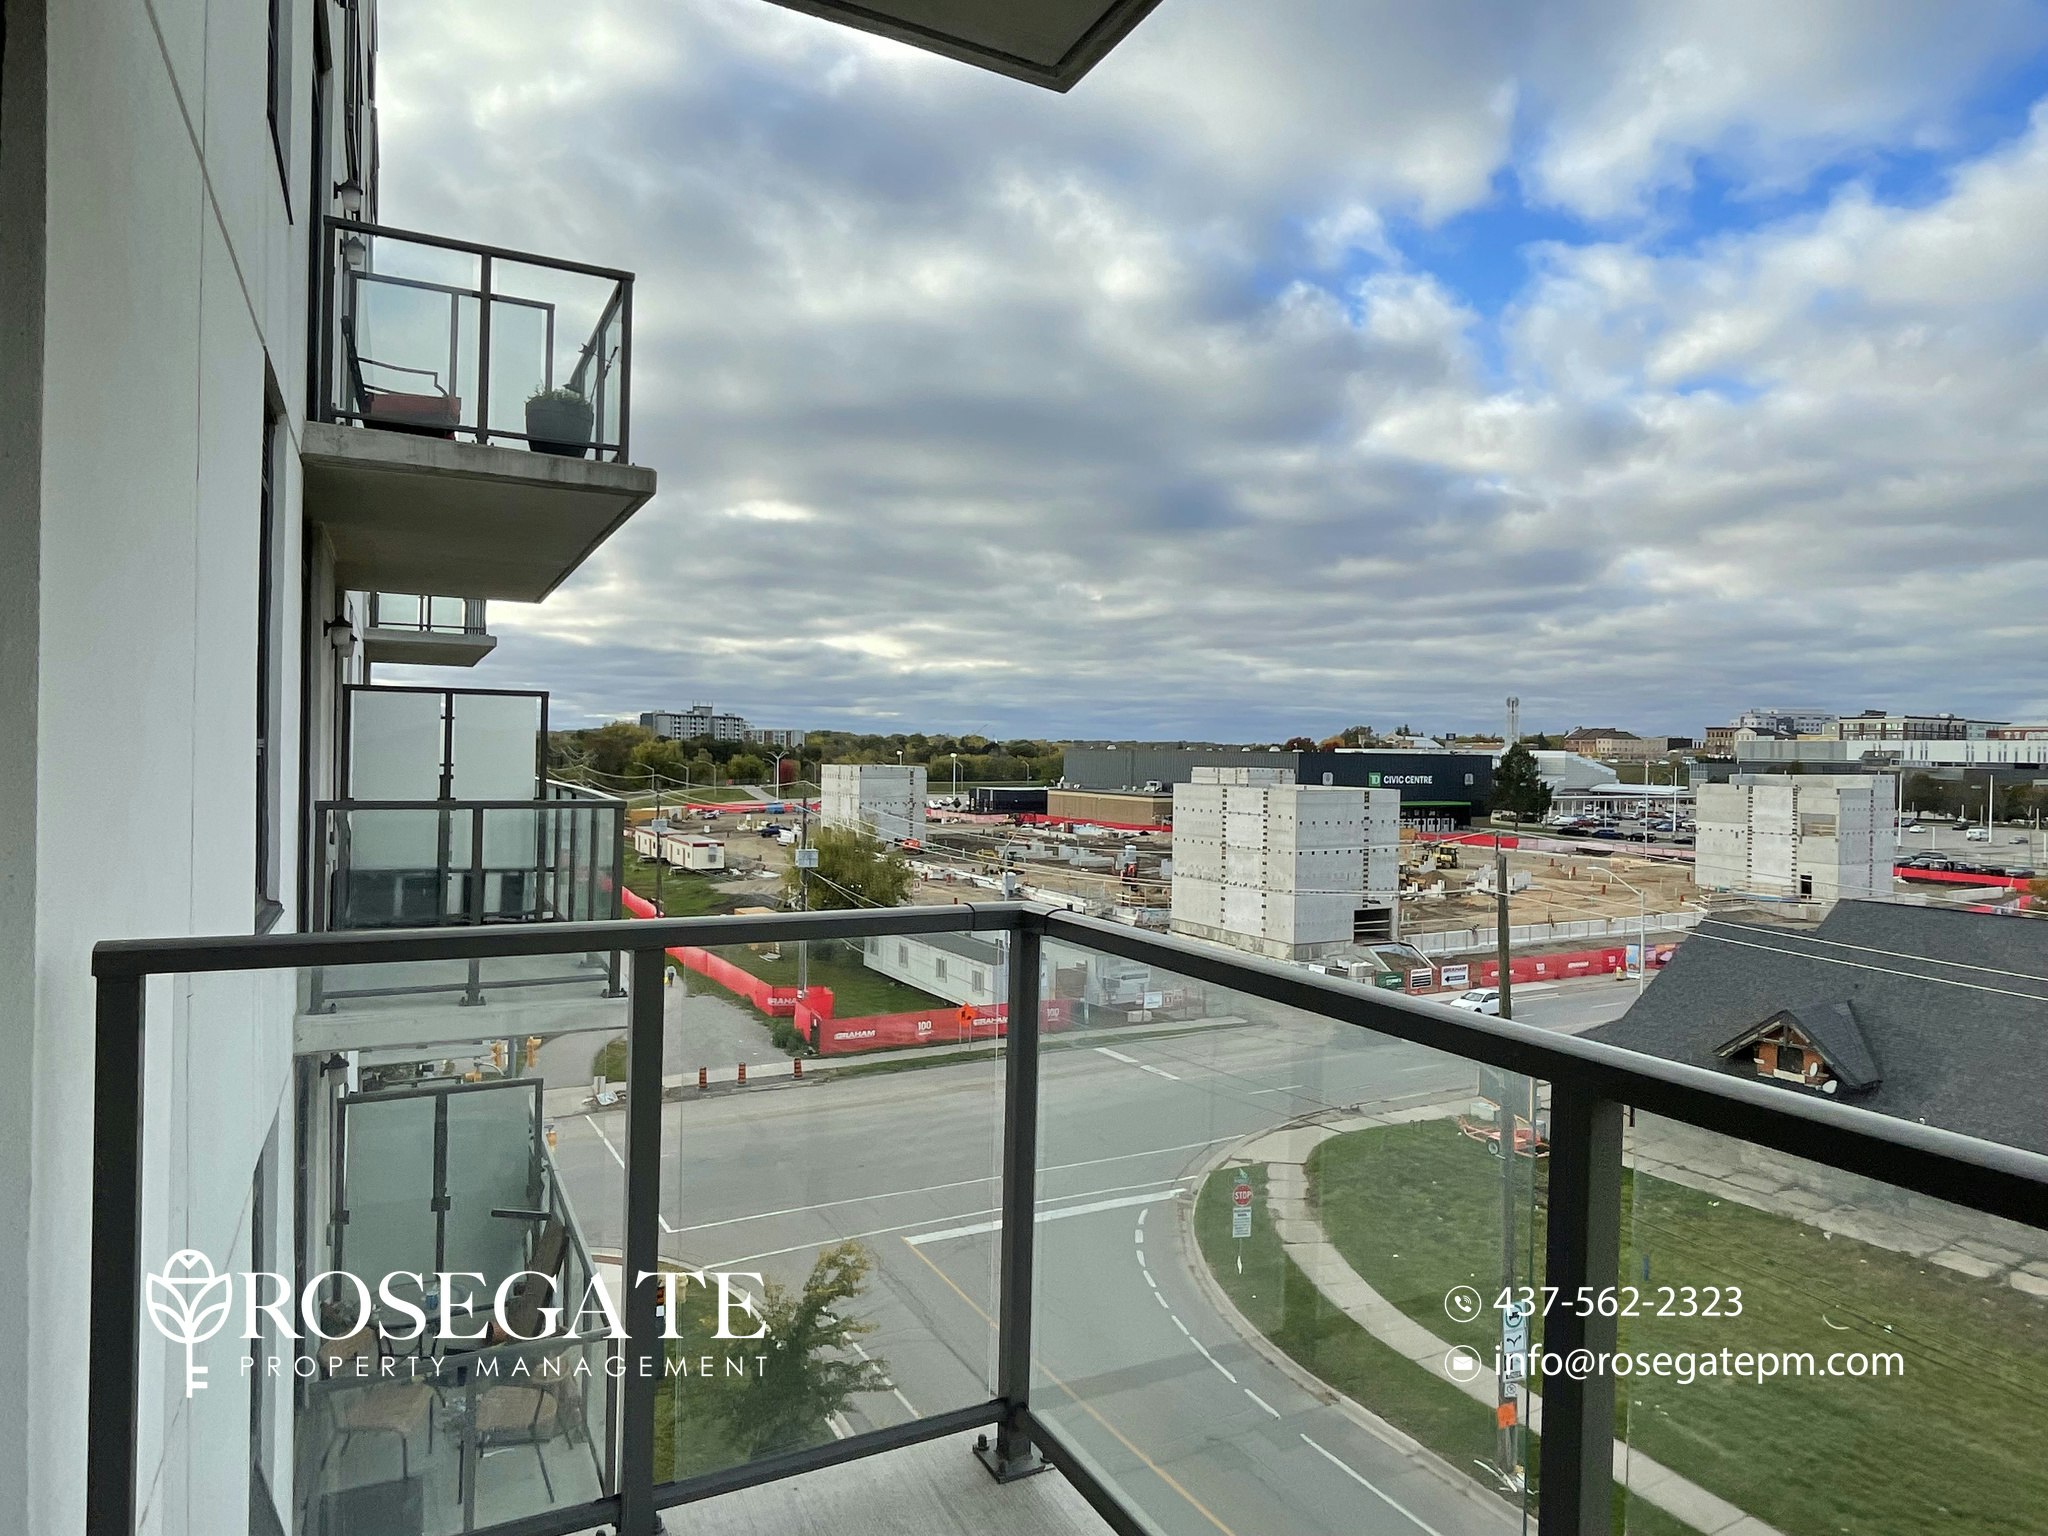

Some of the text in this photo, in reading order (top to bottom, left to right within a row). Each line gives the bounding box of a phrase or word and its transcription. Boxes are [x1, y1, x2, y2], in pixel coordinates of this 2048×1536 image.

[1383, 775, 1404, 784] CIVIC
[1405, 775, 1433, 784] CENTRE
[917, 1020, 932, 1031] 100
[834, 1029, 876, 1040] GRAHAM
[1234, 1191, 1252, 1200] STOP
